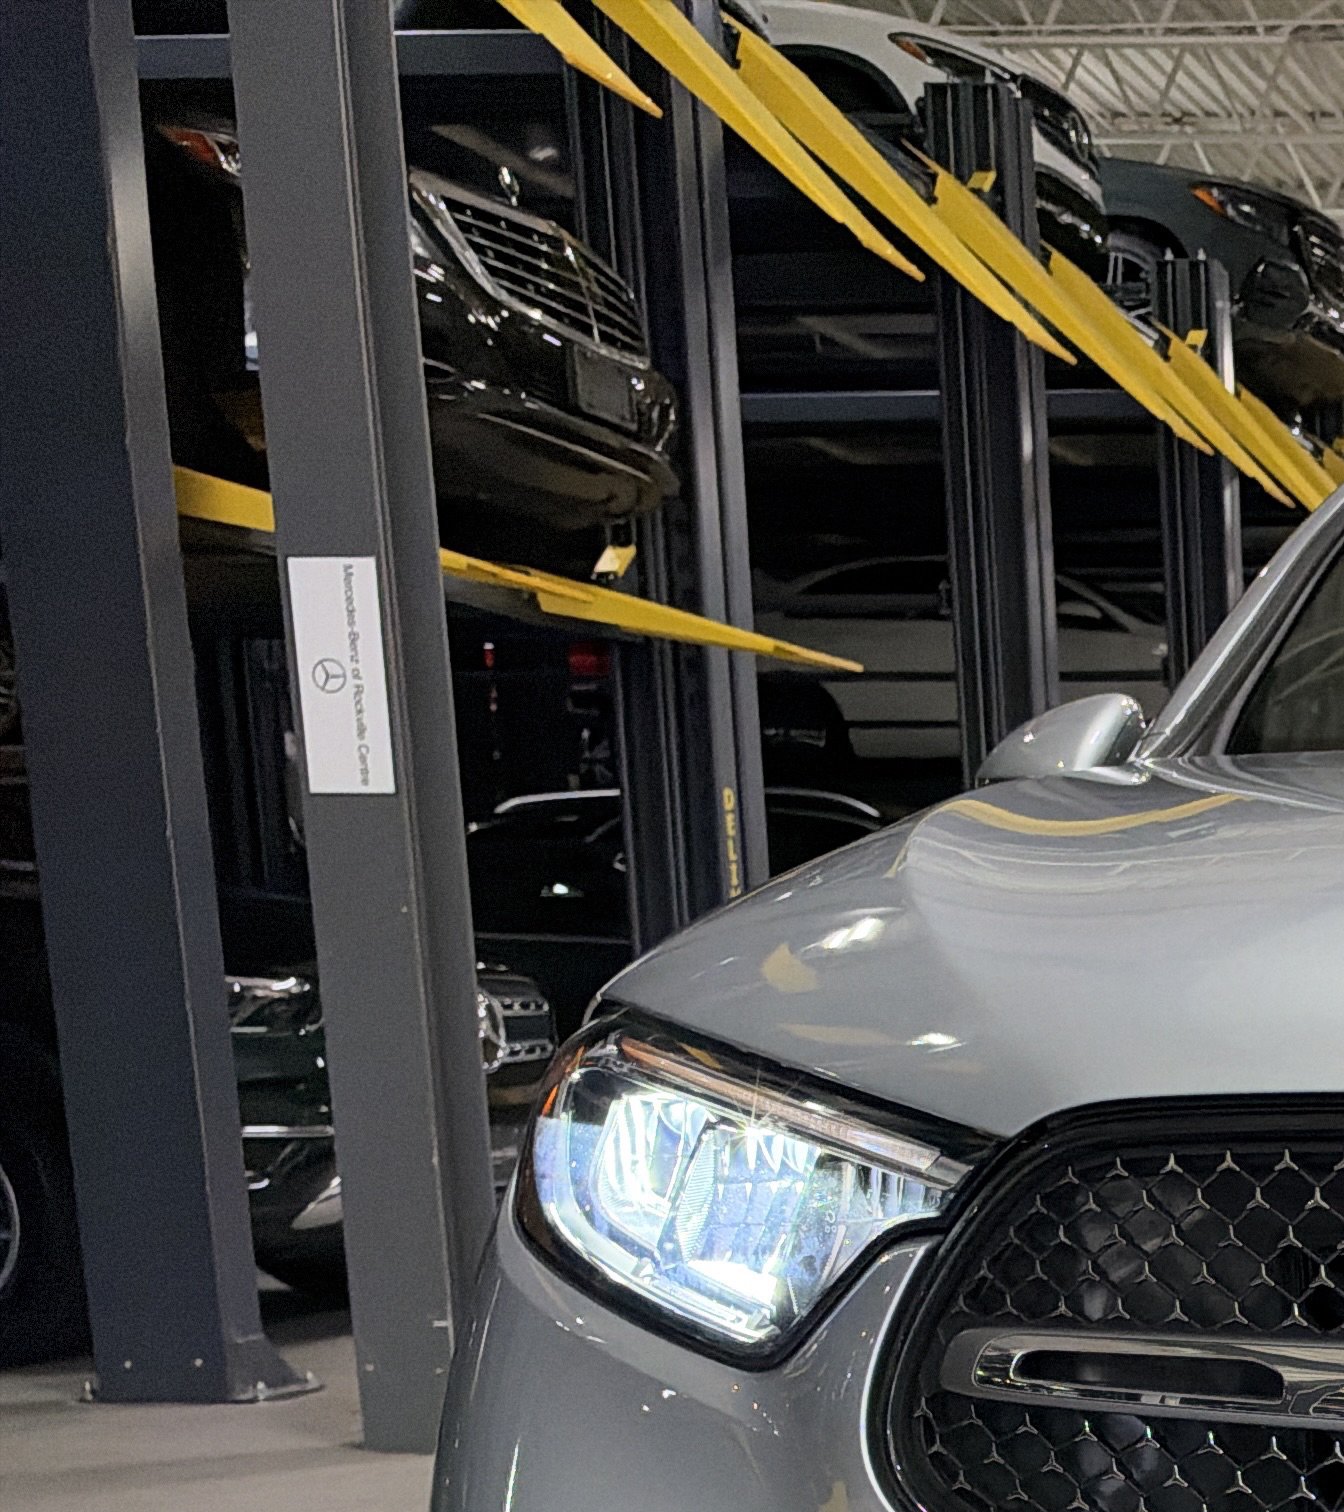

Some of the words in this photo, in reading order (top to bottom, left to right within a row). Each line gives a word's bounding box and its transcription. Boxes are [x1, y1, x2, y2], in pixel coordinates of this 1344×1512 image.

[343, 564, 361, 663] Mercedes-Benz
[351, 666, 363, 681] of
[357, 744, 370, 787] Centre
